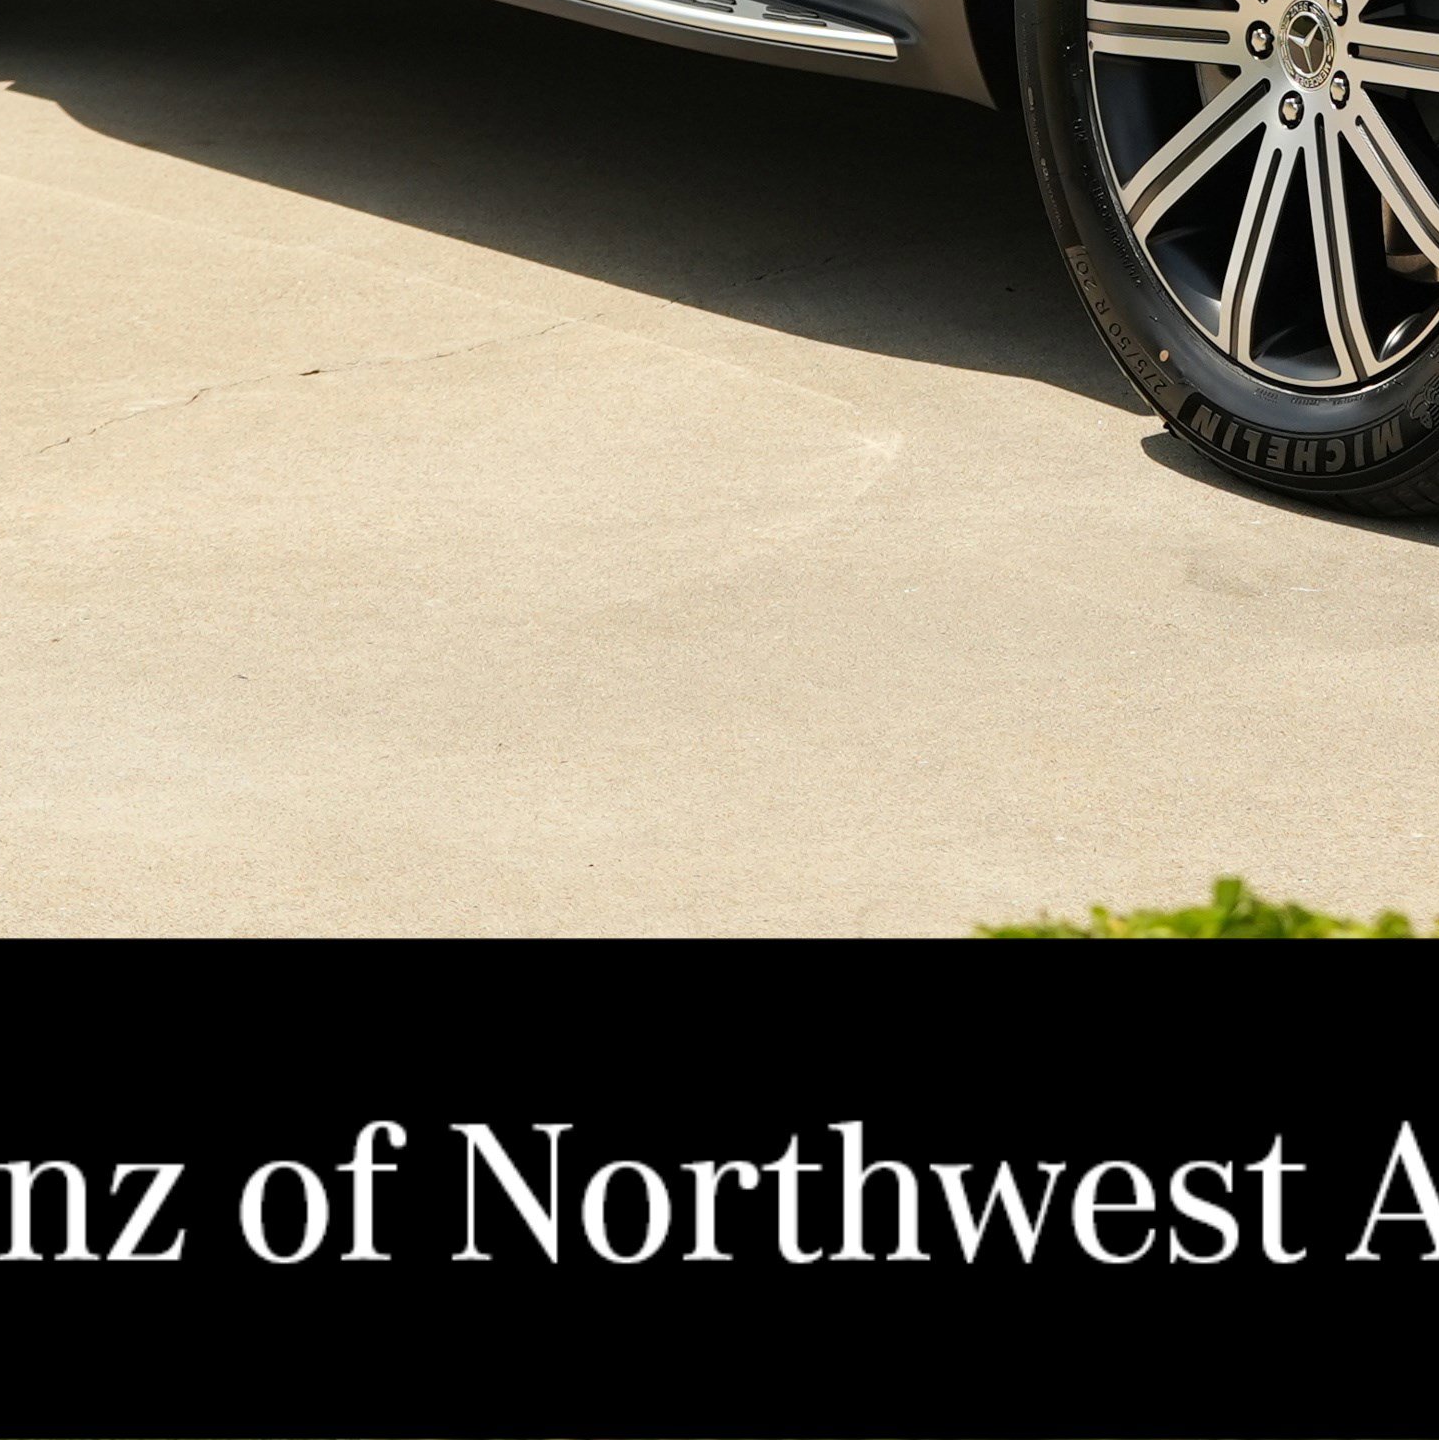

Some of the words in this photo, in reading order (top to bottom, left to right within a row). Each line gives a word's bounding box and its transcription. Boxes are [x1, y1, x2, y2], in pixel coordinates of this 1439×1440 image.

[1095, 298, 1111, 316] R
[1108, 322, 1168, 395] 275/50
[1190, 404, 1405, 473] MICHELIN
